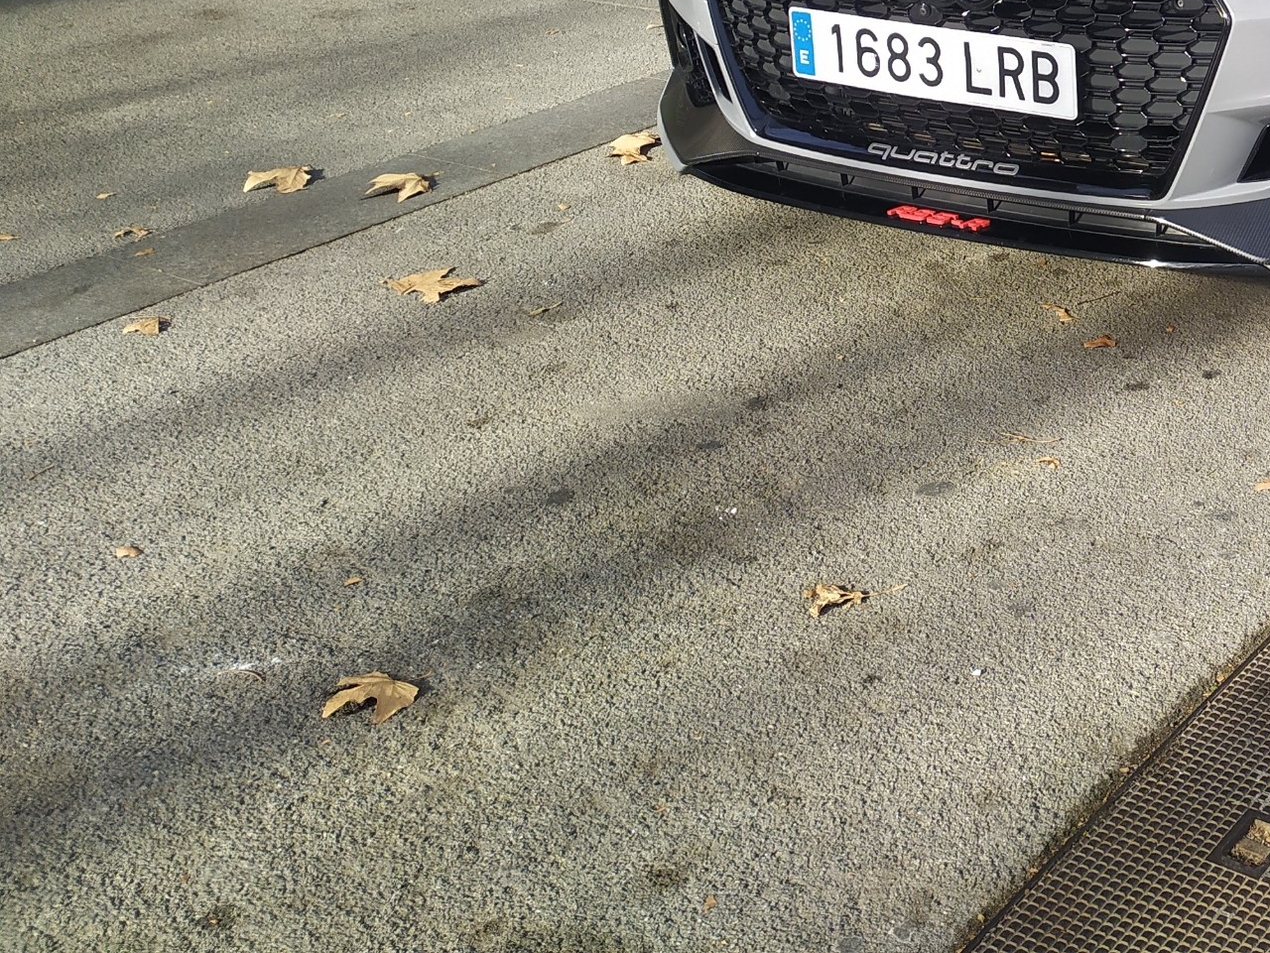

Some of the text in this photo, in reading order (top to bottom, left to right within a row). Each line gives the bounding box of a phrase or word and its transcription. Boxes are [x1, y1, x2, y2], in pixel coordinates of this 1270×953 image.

[800, 49, 810, 65] E
[831, 24, 1060, 105] 1683 LRB
[867, 142, 1019, 176] quattro
